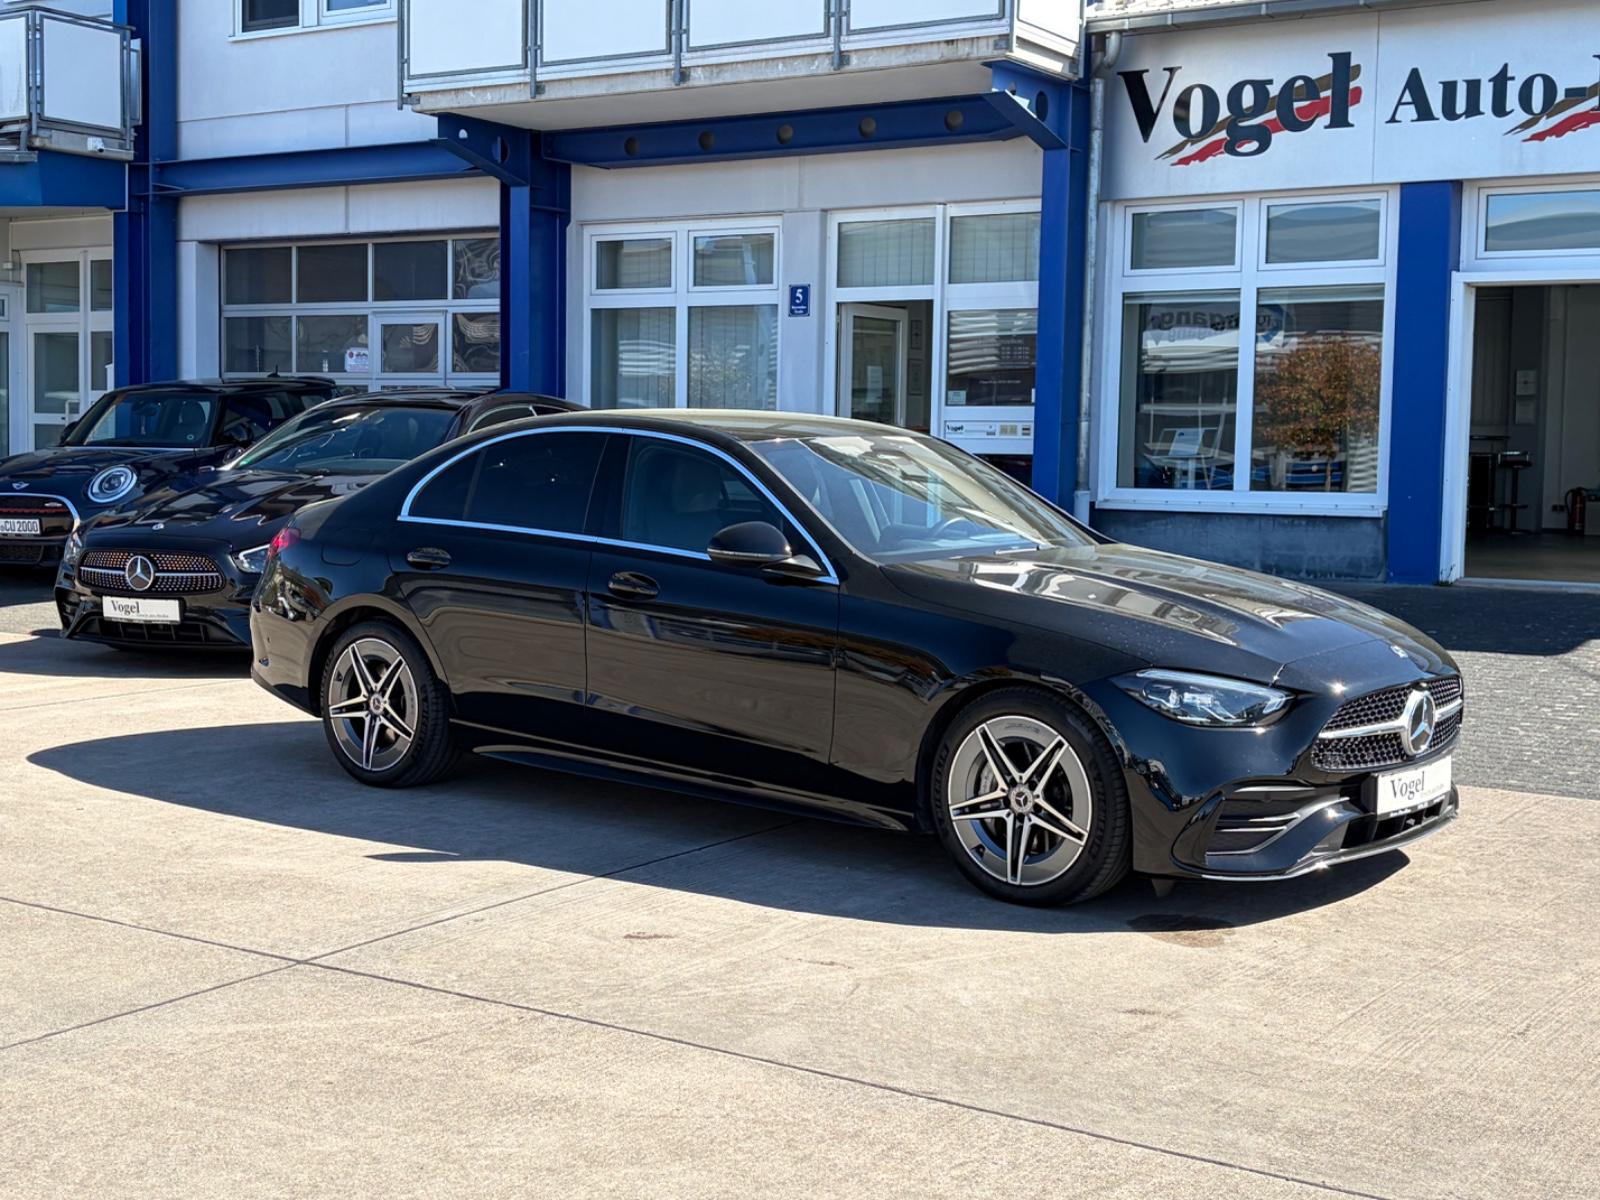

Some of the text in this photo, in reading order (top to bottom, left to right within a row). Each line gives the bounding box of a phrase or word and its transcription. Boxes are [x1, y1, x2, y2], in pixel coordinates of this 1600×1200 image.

[1117, 51, 1600, 157] Vogel Auto-
[795, 288, 803, 303] 5
[17, 520, 38, 533] 2000
[111, 600, 140, 615] Vogel
[1390, 770, 1425, 800] Vogel
